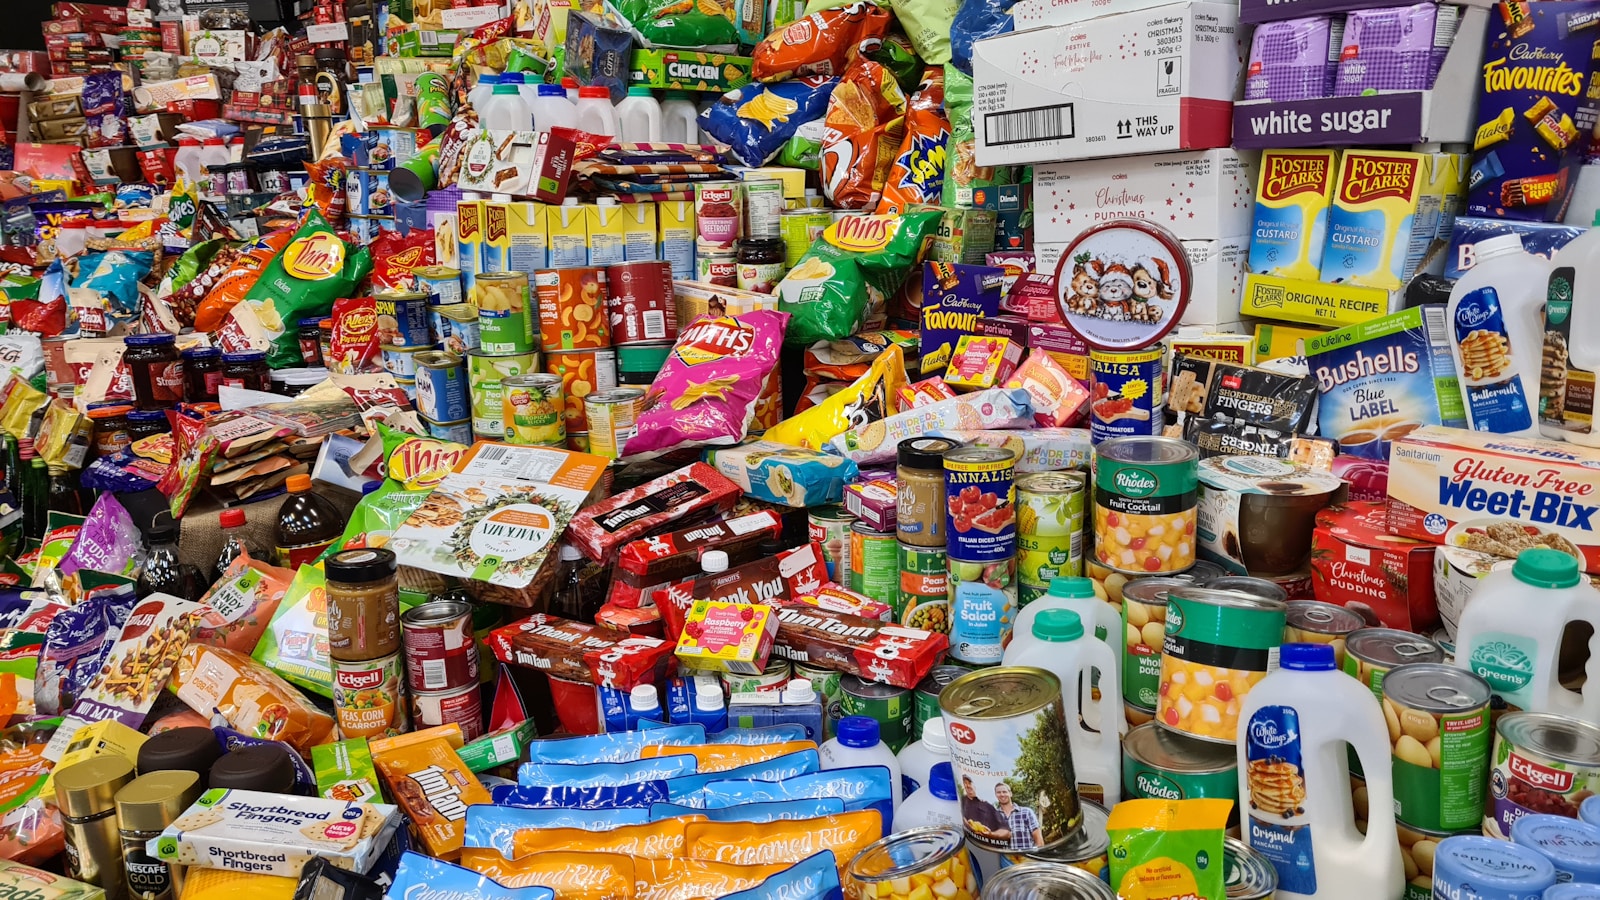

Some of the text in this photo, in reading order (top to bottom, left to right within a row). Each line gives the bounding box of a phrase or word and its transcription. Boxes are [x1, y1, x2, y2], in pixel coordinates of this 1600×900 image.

[1147, 16, 1183, 27] coles Bakery
[1568, 14, 1592, 27] DAIRY
[1148, 26, 1182, 38] CHRISTMAS
[1065, 42, 1091, 50] FESTIVE
[1156, 36, 1182, 46] 3803613
[1158, 46, 1173, 55] 360g
[1509, 42, 1563, 64] Cadbury
[604, 52, 614, 76] Carr's
[669, 63, 719, 80] CHICKEN
[1344, 64, 1366, 75] white
[1250, 78, 1268, 89] white
[1342, 72, 1364, 84] sugar
[1483, 57, 1584, 96] Favourites
[1250, 87, 1268, 97] sugar
[1136, 116, 1158, 126] THIS
[1251, 106, 1392, 135] white sugar
[1136, 125, 1174, 137] WAY UP
[1476, 123, 1508, 144] flake
[1271, 156, 1323, 175] FOSTER
[1351, 157, 1411, 178] FOSTER
[266, 180, 283, 188] IXL
[1267, 170, 1323, 198] CLARKS
[1346, 174, 1410, 201] CLARKS
[703, 191, 730, 200] Edgell
[1095, 186, 1145, 208] Christmas
[1094, 210, 1145, 220] PUDDING
[705, 224, 730, 232] BEETROOT
[1256, 228, 1298, 240] CUSTARD
[1332, 233, 1379, 247] CUSTARD
[274, 278, 291, 294] Chicken
[1256, 286, 1282, 296] FOSTER
[942, 294, 982, 312] Cadbury
[1254, 294, 1282, 306] CLARKS
[1286, 292, 1379, 313] ORIGINAL RECIPE
[376, 301, 395, 315] SPAM
[1315, 308, 1336, 318] NET 1L
[1462, 306, 1479, 321] White
[346, 315, 373, 326] Allen's
[922, 303, 986, 332] Favouri
[1470, 310, 1489, 324] Wings
[984, 324, 1012, 336] port wine
[1321, 332, 1352, 347] Lifeline
[923, 354, 948, 367] flake
[1179, 349, 1239, 360] FOSTER
[1316, 346, 1418, 393] Bushells
[418, 379, 432, 394] HAM
[1027, 367, 1059, 391] Aeroplane
[1353, 388, 1386, 403] Blue
[1471, 385, 1520, 402] Buttermilk
[1582, 385, 1592, 393] Chip
[1219, 389, 1275, 405] SHORTBREAD
[1473, 400, 1498, 408] PANCAKES
[1217, 396, 1272, 416] FINGERS
[1350, 398, 1399, 421] LABEL
[888, 413, 937, 432] HUNDREDS
[890, 420, 945, 439] THOUSANDS
[1221, 434, 1278, 455] FINGERS
[1027, 448, 1083, 458] HUNDREDS
[1396, 446, 1441, 462] Sanitarium
[722, 461, 740, 472] Original
[1117, 473, 1154, 489] Rhodes
[1453, 457, 1593, 495] Gluten Free
[1110, 499, 1160, 511] Fruit Cocktail
[1439, 476, 1599, 531] Weet-Bix
[602, 504, 650, 528] TimTam
[684, 524, 725, 542] TimTam
[717, 573, 741, 584] ARNOTT'S
[1330, 562, 1385, 588] Christmas
[752, 577, 784, 601] You
[1330, 578, 1386, 600] PUDDING
[963, 600, 992, 611] Fruit
[778, 608, 875, 637] TimTam
[961, 610, 996, 621] Salad
[704, 618, 746, 629] Raspberry
[529, 625, 616, 648] Thank You
[515, 651, 551, 668] TimTam
[563, 658, 580, 668] Original
[826, 651, 848, 663] Original
[1139, 657, 1160, 666] whol
[275, 661, 332, 681] ORIGINAL FLAVOU
[1139, 666, 1160, 676] pota
[1478, 666, 1526, 685] Green's
[340, 672, 379, 687] Edgell
[75, 702, 124, 721] NUT MIX
[342, 709, 384, 722] PEAS, CORN
[348, 720, 387, 729] CARROTS
[1255, 726, 1277, 738] White
[951, 727, 972, 743] spc
[1263, 733, 1287, 747] Wings
[963, 767, 985, 776] MANGO
[1512, 757, 1565, 786] Edgell
[407, 765, 468, 822] TimTam
[825, 780, 864, 799] Rice
[1138, 775, 1179, 800] Rhodes
[226, 802, 331, 822] Shortbread
[234, 811, 302, 827] Fingers
[328, 825, 352, 833] NEW
[1253, 825, 1295, 844] Original
[646, 834, 684, 850] Rice
[716, 828, 858, 863] Creamed Rice
[1254, 840, 1282, 851] PANCAKES
[209, 846, 286, 862] Shortbread
[1452, 852, 1537, 871] Wild Tides
[223, 858, 273, 872] Fingers
[131, 871, 164, 885] GOLD
[477, 864, 612, 888] Creamed Rice
[780, 874, 815, 900] Rice
[1434, 874, 1460, 900] Wild
